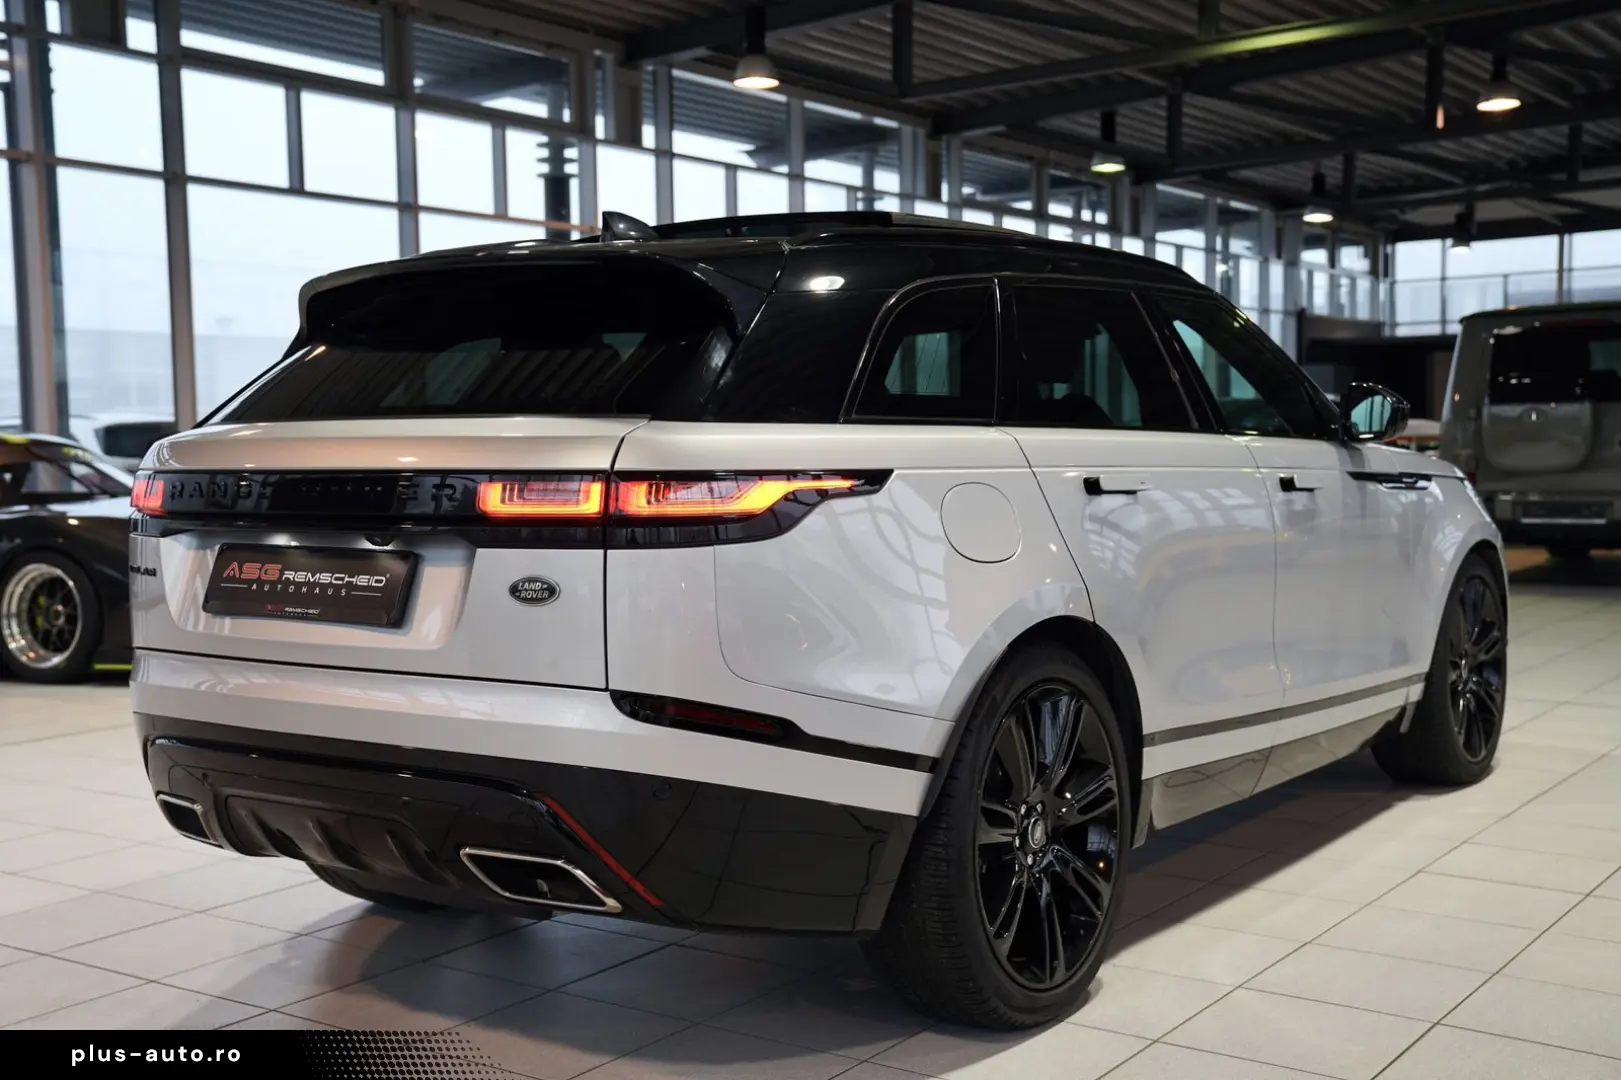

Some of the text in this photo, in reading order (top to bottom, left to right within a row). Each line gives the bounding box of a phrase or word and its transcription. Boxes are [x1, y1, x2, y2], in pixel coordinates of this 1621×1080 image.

[223, 561, 387, 587] ASG REMSCHEID
[251, 583, 347, 596] AUTOHAUS
[518, 582, 542, 590] LAND
[520, 590, 549, 598] ROVER
